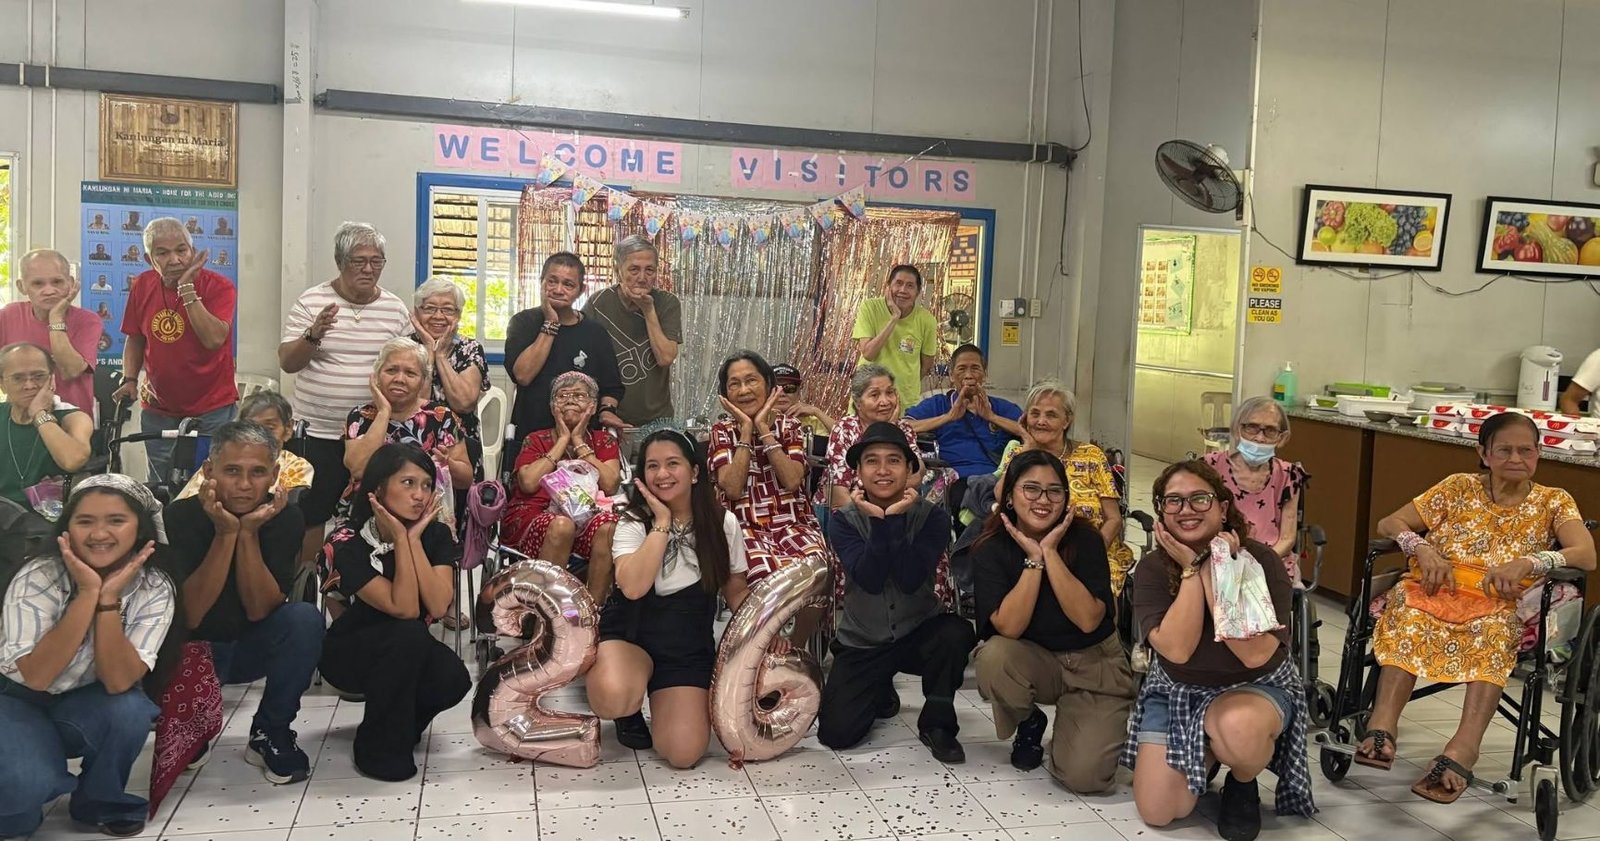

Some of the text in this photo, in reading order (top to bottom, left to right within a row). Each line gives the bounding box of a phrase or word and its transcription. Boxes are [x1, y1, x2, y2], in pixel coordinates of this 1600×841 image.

[115, 131, 224, 147] Kanlungan ni Maria
[438, 133, 969, 192] WELCOME VISITORS
[1250, 299, 1280, 308] PLEASE
[107, 358, 123, 366] AND
[471, 553, 828, 768] 2 6
